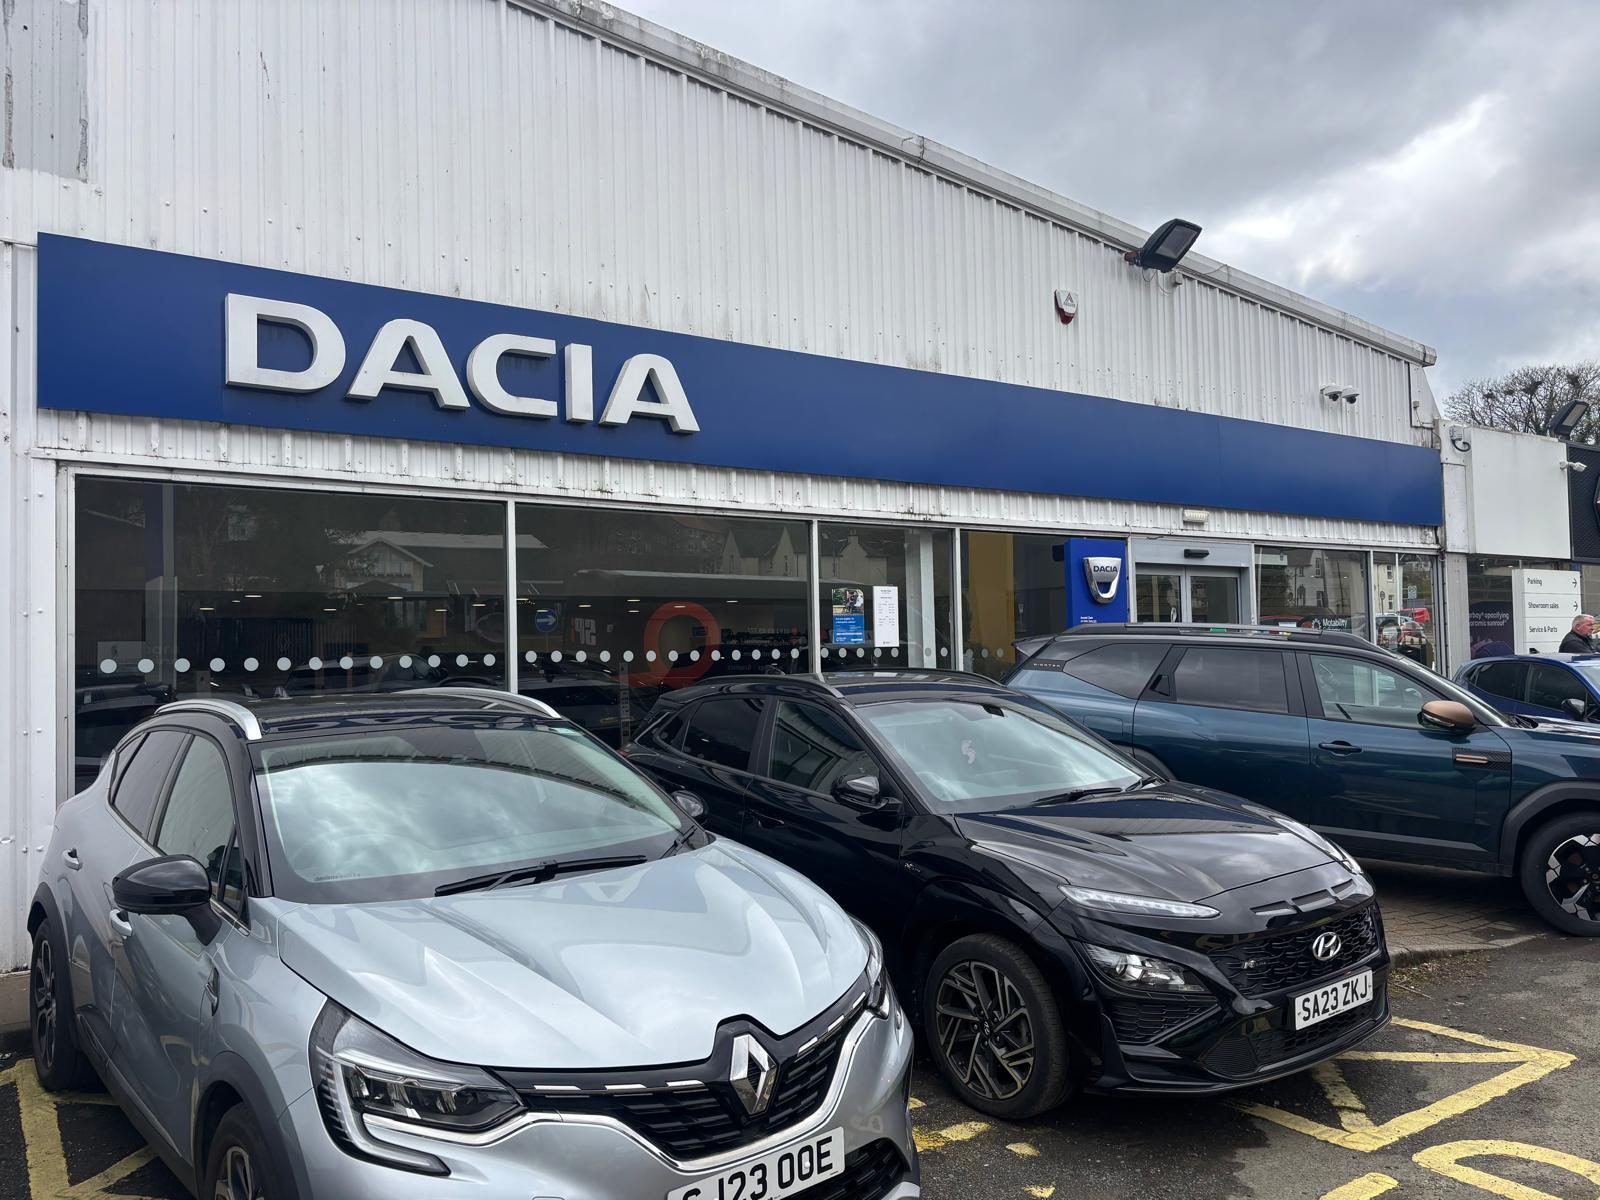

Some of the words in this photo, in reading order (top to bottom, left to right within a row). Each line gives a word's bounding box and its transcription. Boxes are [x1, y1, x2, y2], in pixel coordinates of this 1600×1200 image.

[224, 292, 700, 434] DACIA
[1093, 565, 1118, 573] DACIA
[1527, 577, 1543, 586] Parking
[1528, 601, 1550, 609] Showroom
[1322, 617, 1348, 628] Motability
[1529, 625, 1543, 633] Service
[1547, 625, 1558, 633] Parts
[1301, 986, 1339, 1022] SA23
[1342, 975, 1368, 1007] ZKJ
[777, 1135, 833, 1190] OOE
